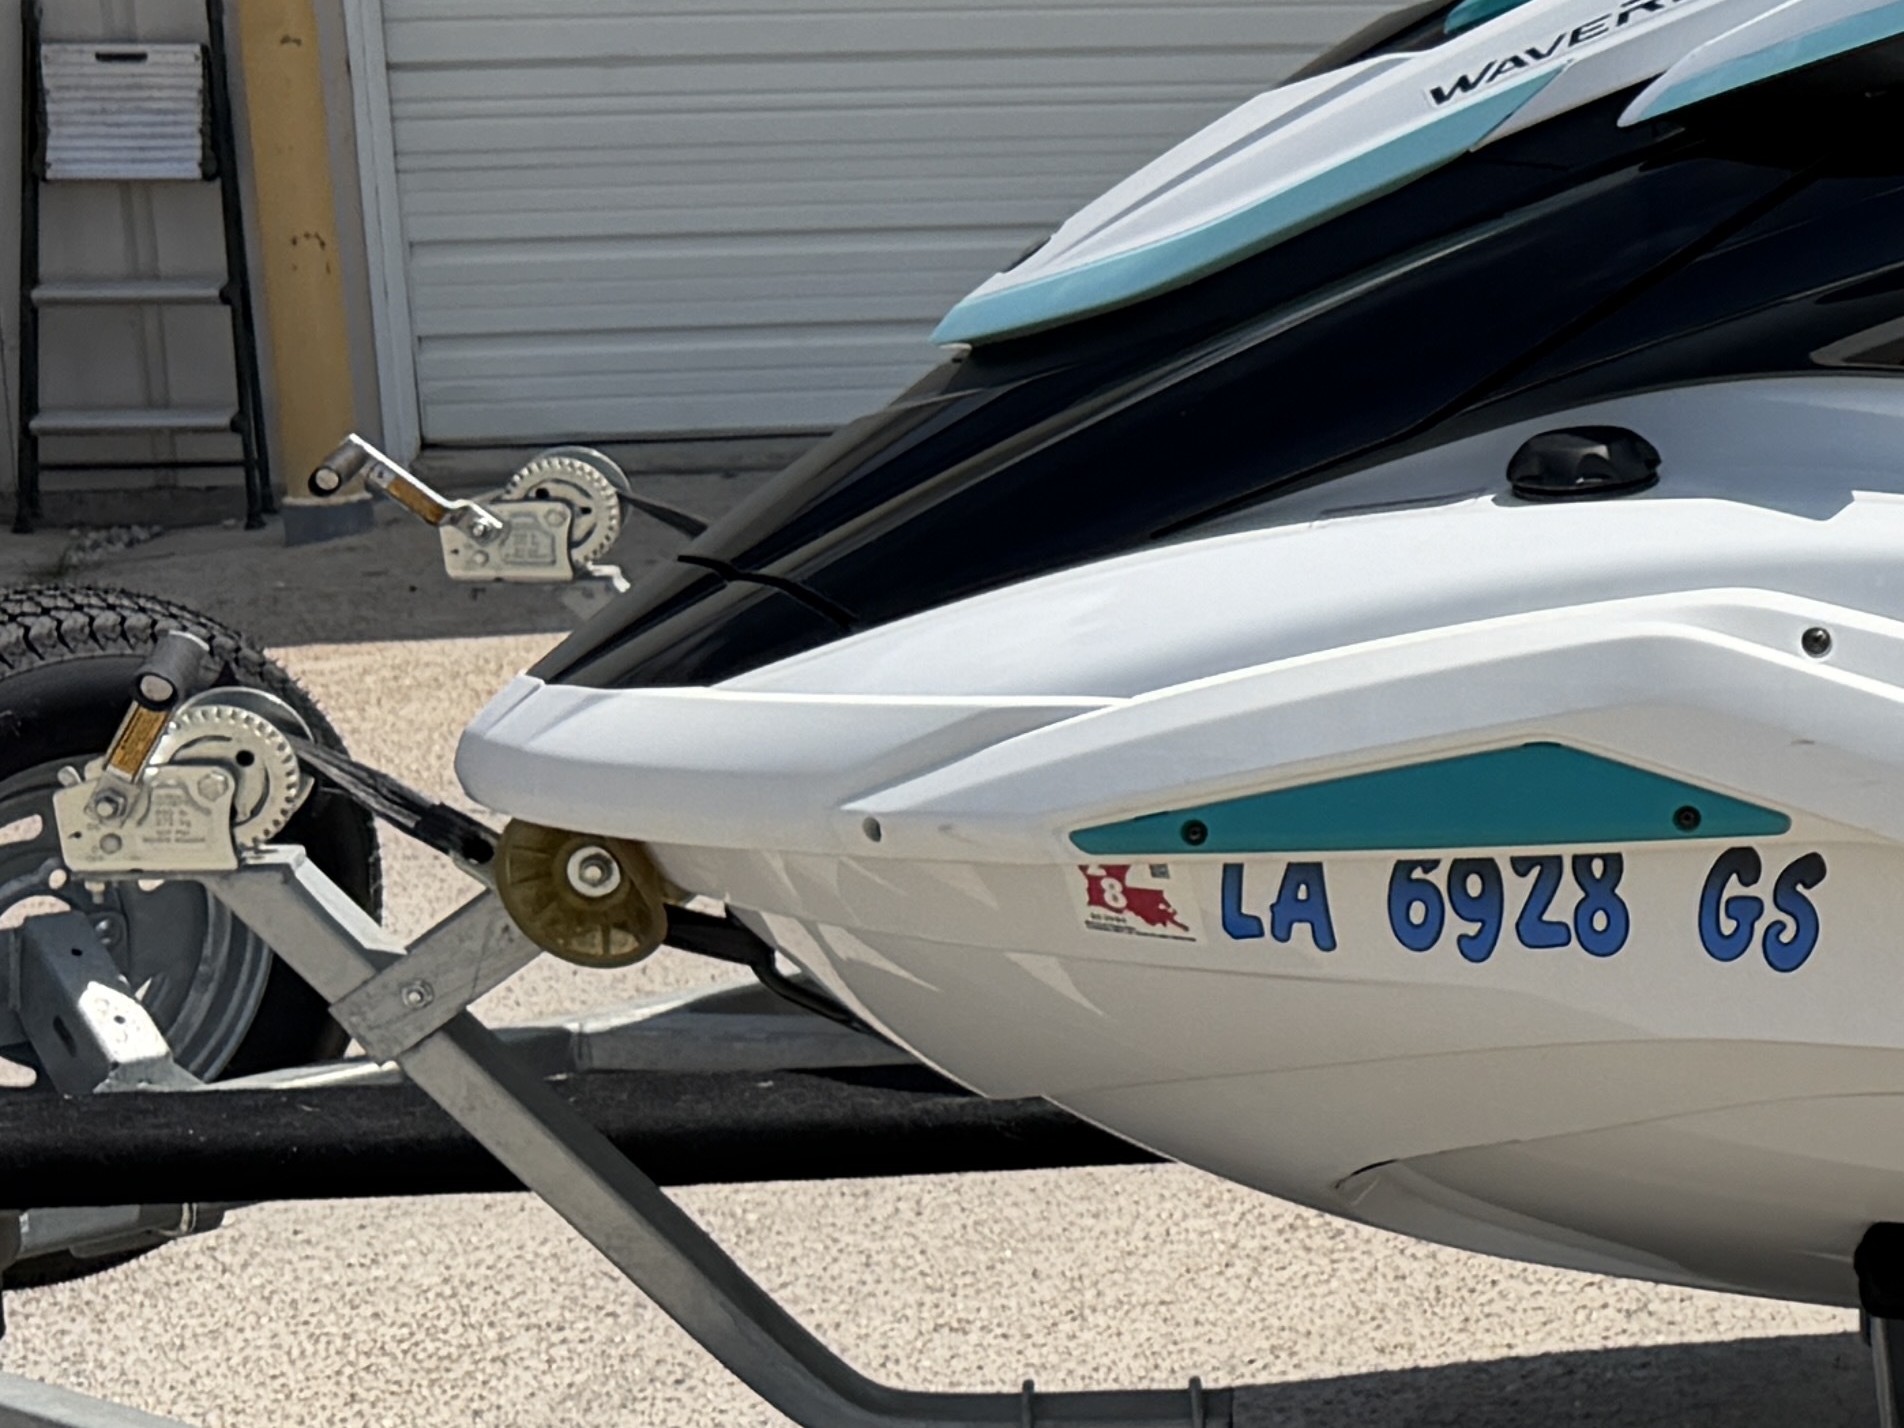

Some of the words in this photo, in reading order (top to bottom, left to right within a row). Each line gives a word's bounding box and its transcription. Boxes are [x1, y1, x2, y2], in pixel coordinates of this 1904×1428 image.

[1220, 861, 1338, 952] LA
[1386, 852, 1631, 964] 6928
[1697, 846, 1828, 973] GS
